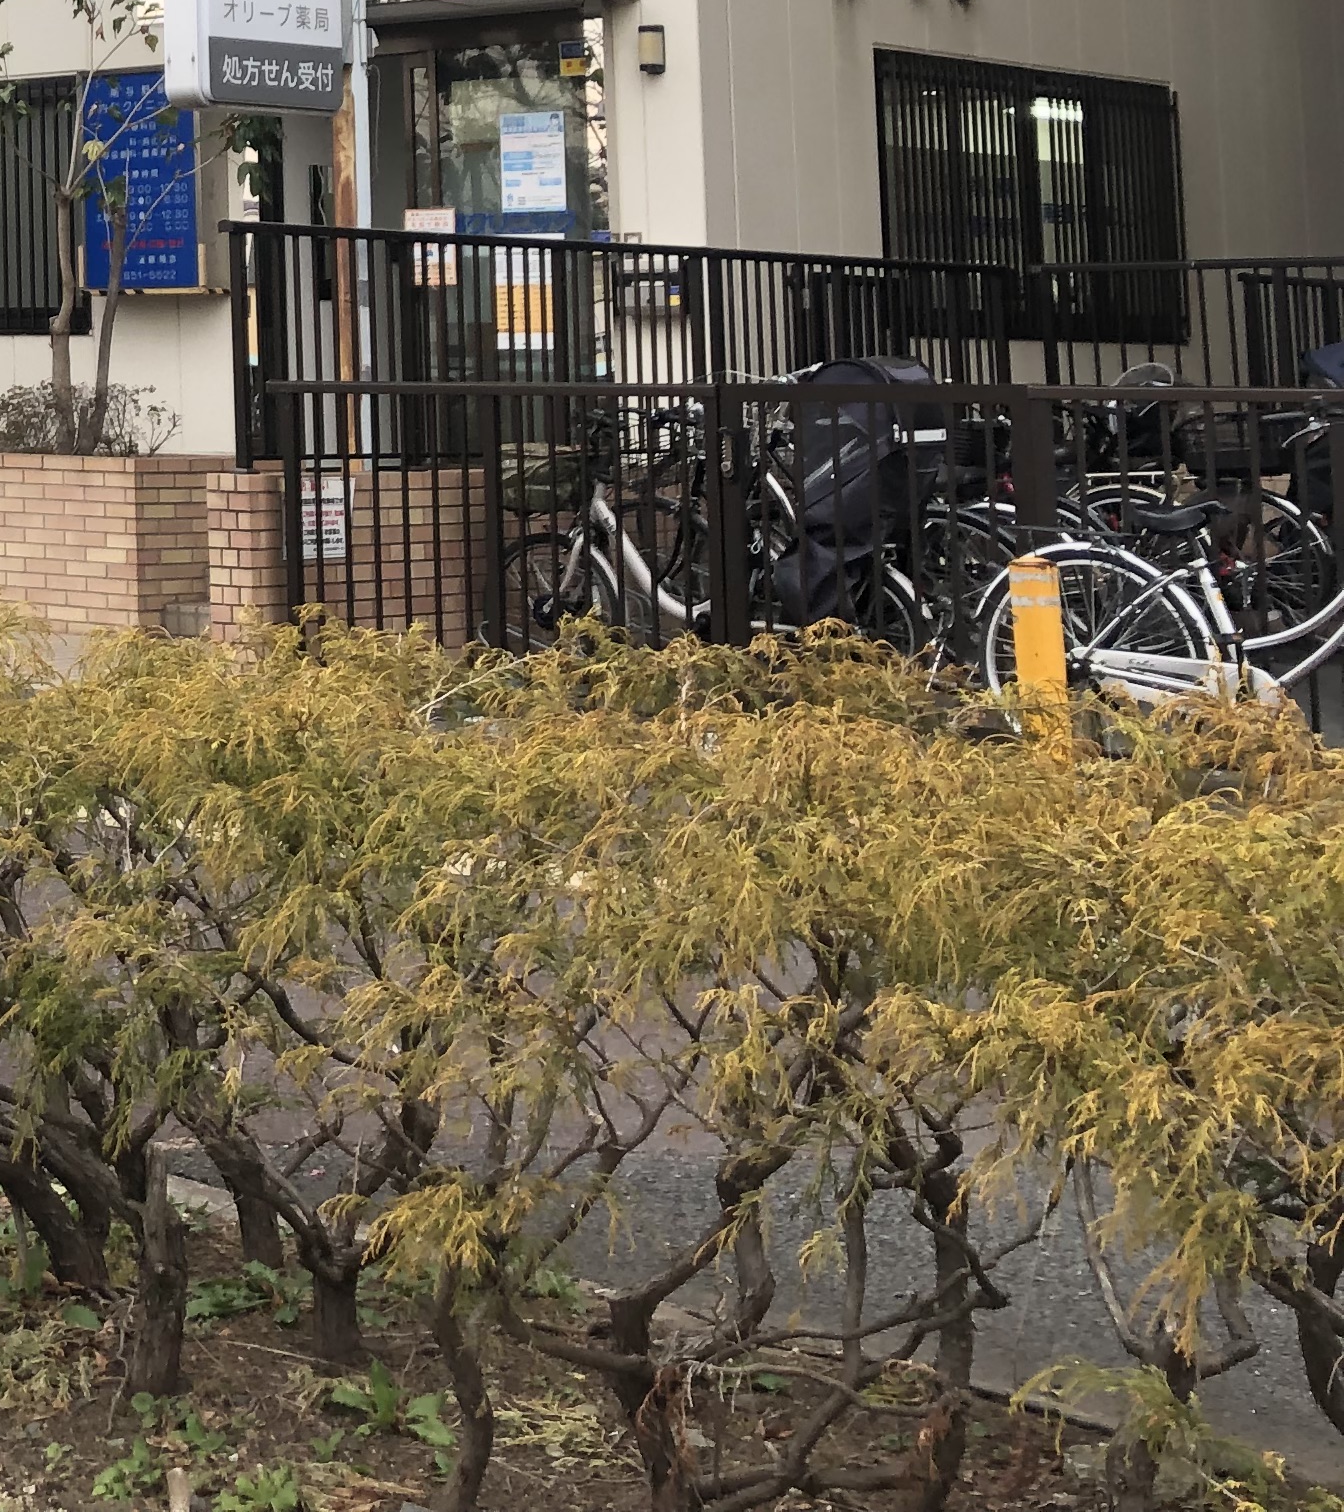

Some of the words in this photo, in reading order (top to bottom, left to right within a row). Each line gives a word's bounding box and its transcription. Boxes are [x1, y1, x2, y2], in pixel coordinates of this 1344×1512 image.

[223, 0, 329, 32] オリーブ薬局
[222, 54, 334, 92] 処方せん受付
